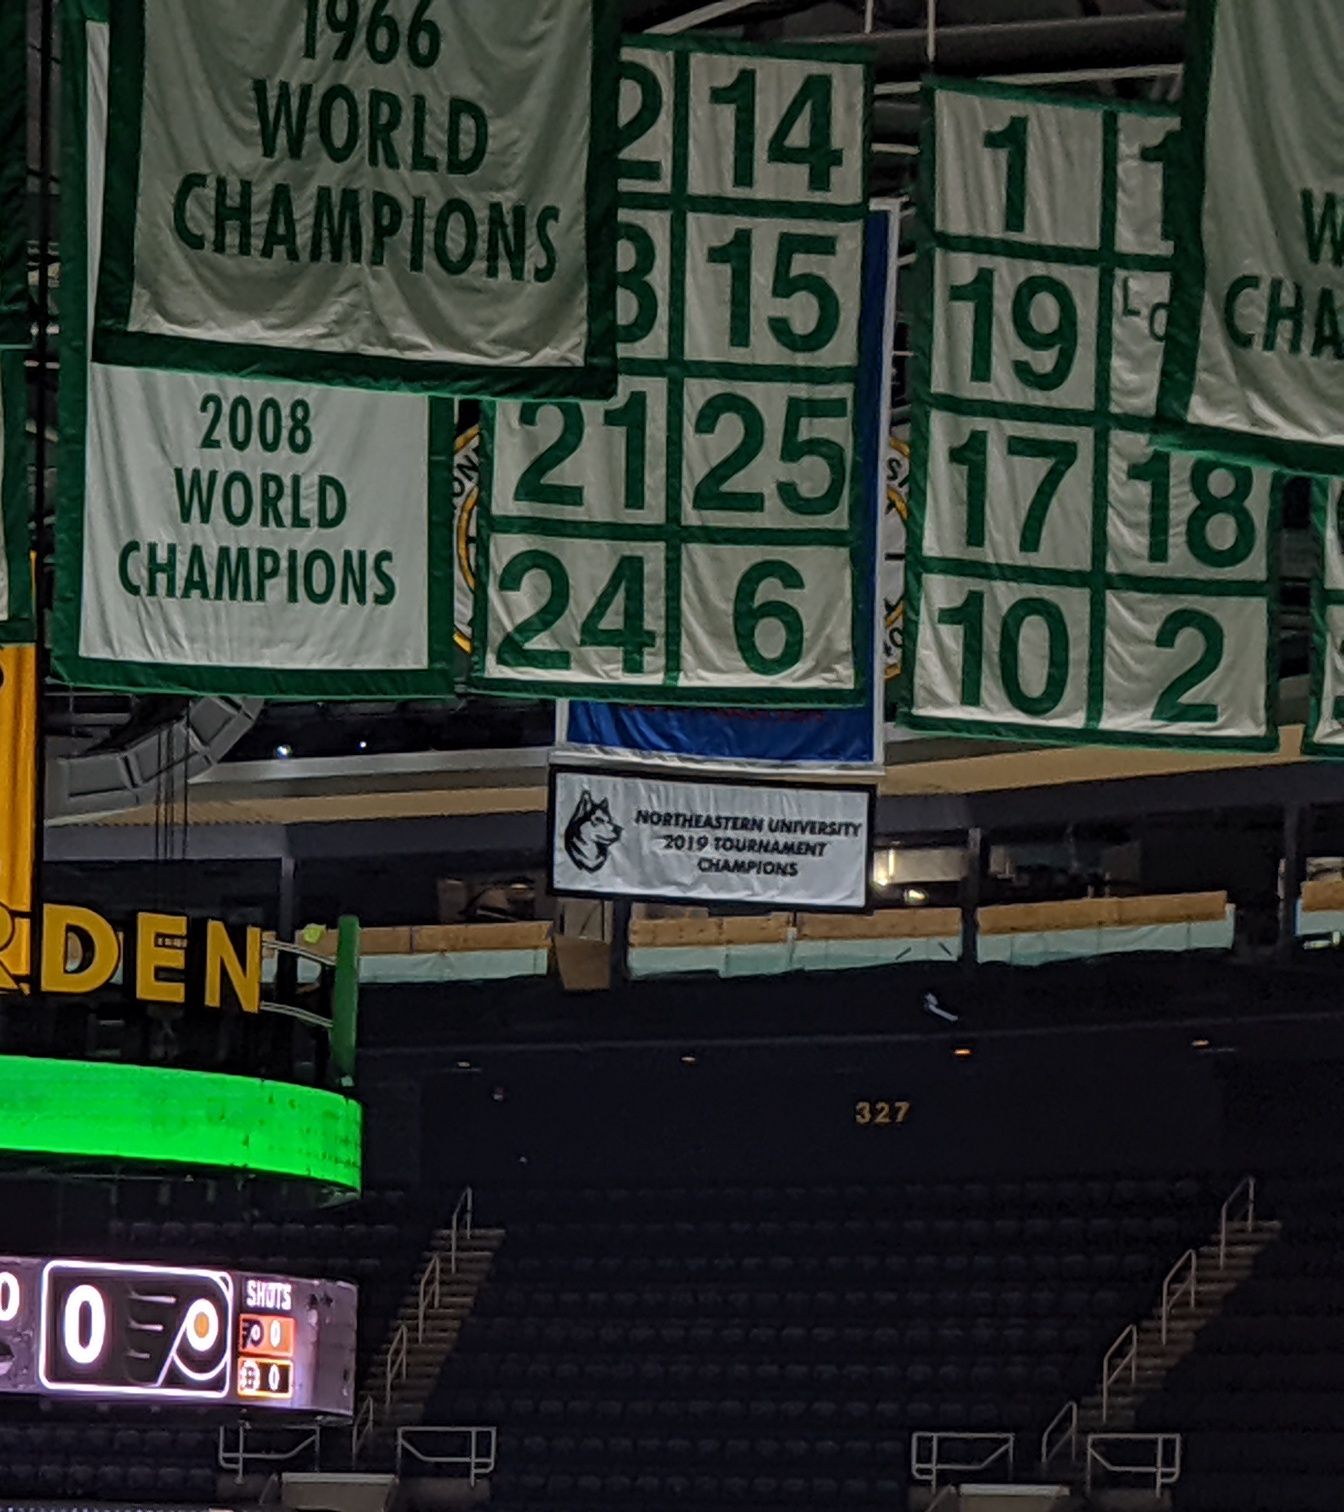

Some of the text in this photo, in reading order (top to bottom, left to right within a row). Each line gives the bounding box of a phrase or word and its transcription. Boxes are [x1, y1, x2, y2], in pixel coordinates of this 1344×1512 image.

[302, 0, 442, 69] 1966
[252, 78, 490, 177] WORLD
[710, 70, 844, 193] 14
[984, 116, 1030, 234] 1
[173, 172, 561, 286] CHAMPIONS
[708, 228, 842, 353] 15
[949, 268, 1079, 393] 19
[199, 393, 313, 455] 2008
[513, 391, 649, 512] 21
[692, 394, 847, 518] 25
[174, 467, 348, 530] WORLD
[949, 429, 1079, 554] 17
[1126, 449, 1256, 569] 18
[117, 540, 397, 607] CHAMPIONS
[496, 550, 656, 676] 24
[733, 559, 806, 676] 6
[937, 589, 1070, 717] 10
[1151, 608, 1225, 723] 2
[634, 808, 864, 840] NORTHEASTERN UNIVERSITY
[662, 834, 829, 859] 2019 TOURNAMENT
[696, 858, 799, 879] CHAMPIONS
[855, 1100, 911, 1125] 327
[63, 1284, 106, 1365] 0
[246, 1279, 292, 1311] SHOTS
[269, 1319, 282, 1348] 0
[268, 1363, 281, 1391] 0
